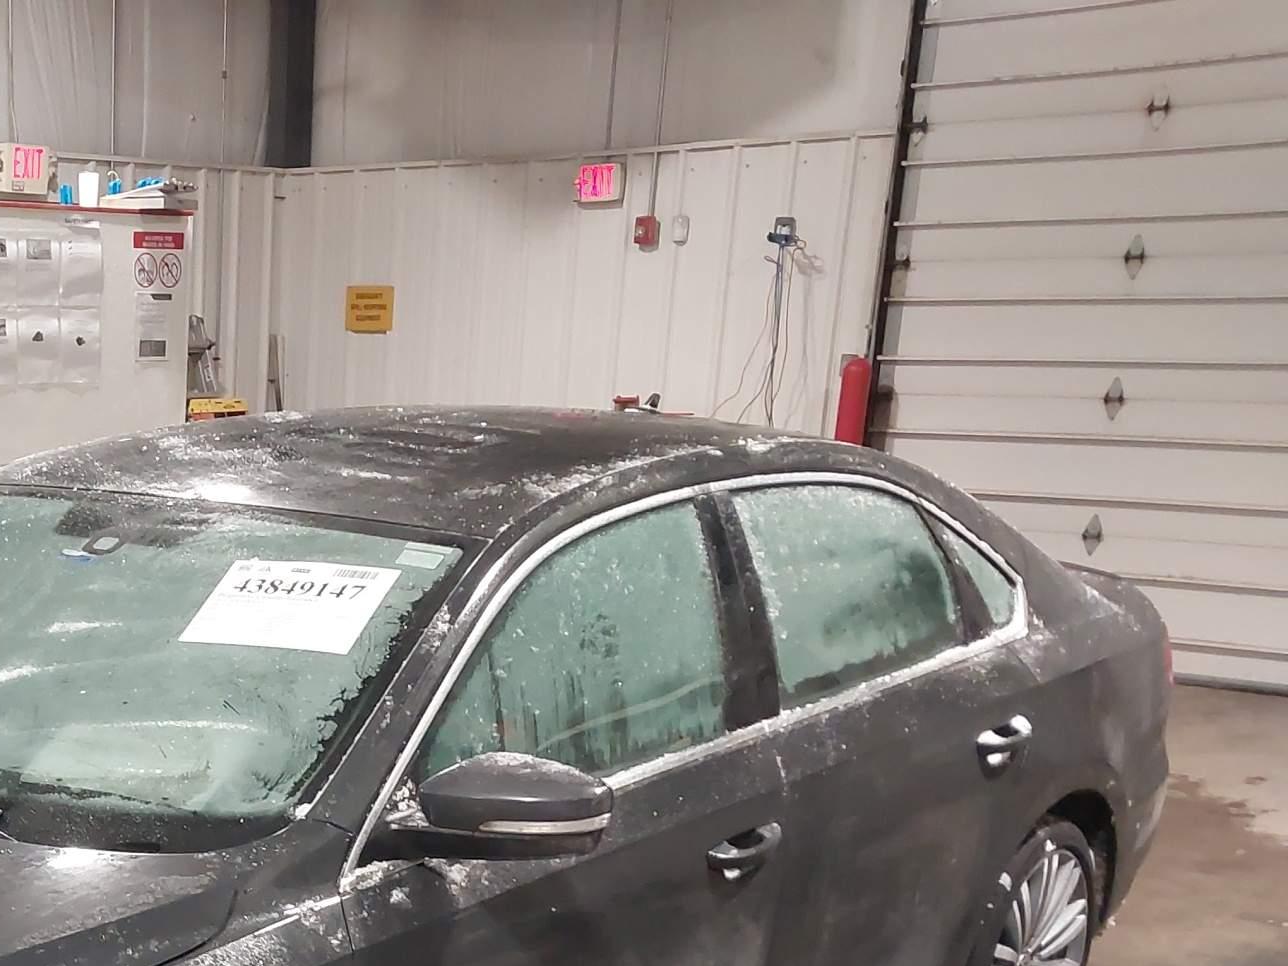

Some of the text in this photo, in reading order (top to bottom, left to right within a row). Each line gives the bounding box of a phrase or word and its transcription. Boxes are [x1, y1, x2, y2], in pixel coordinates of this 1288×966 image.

[13, 146, 43, 180] EXIT
[580, 165, 614, 198] EXIT
[234, 578, 367, 600] 43849147
